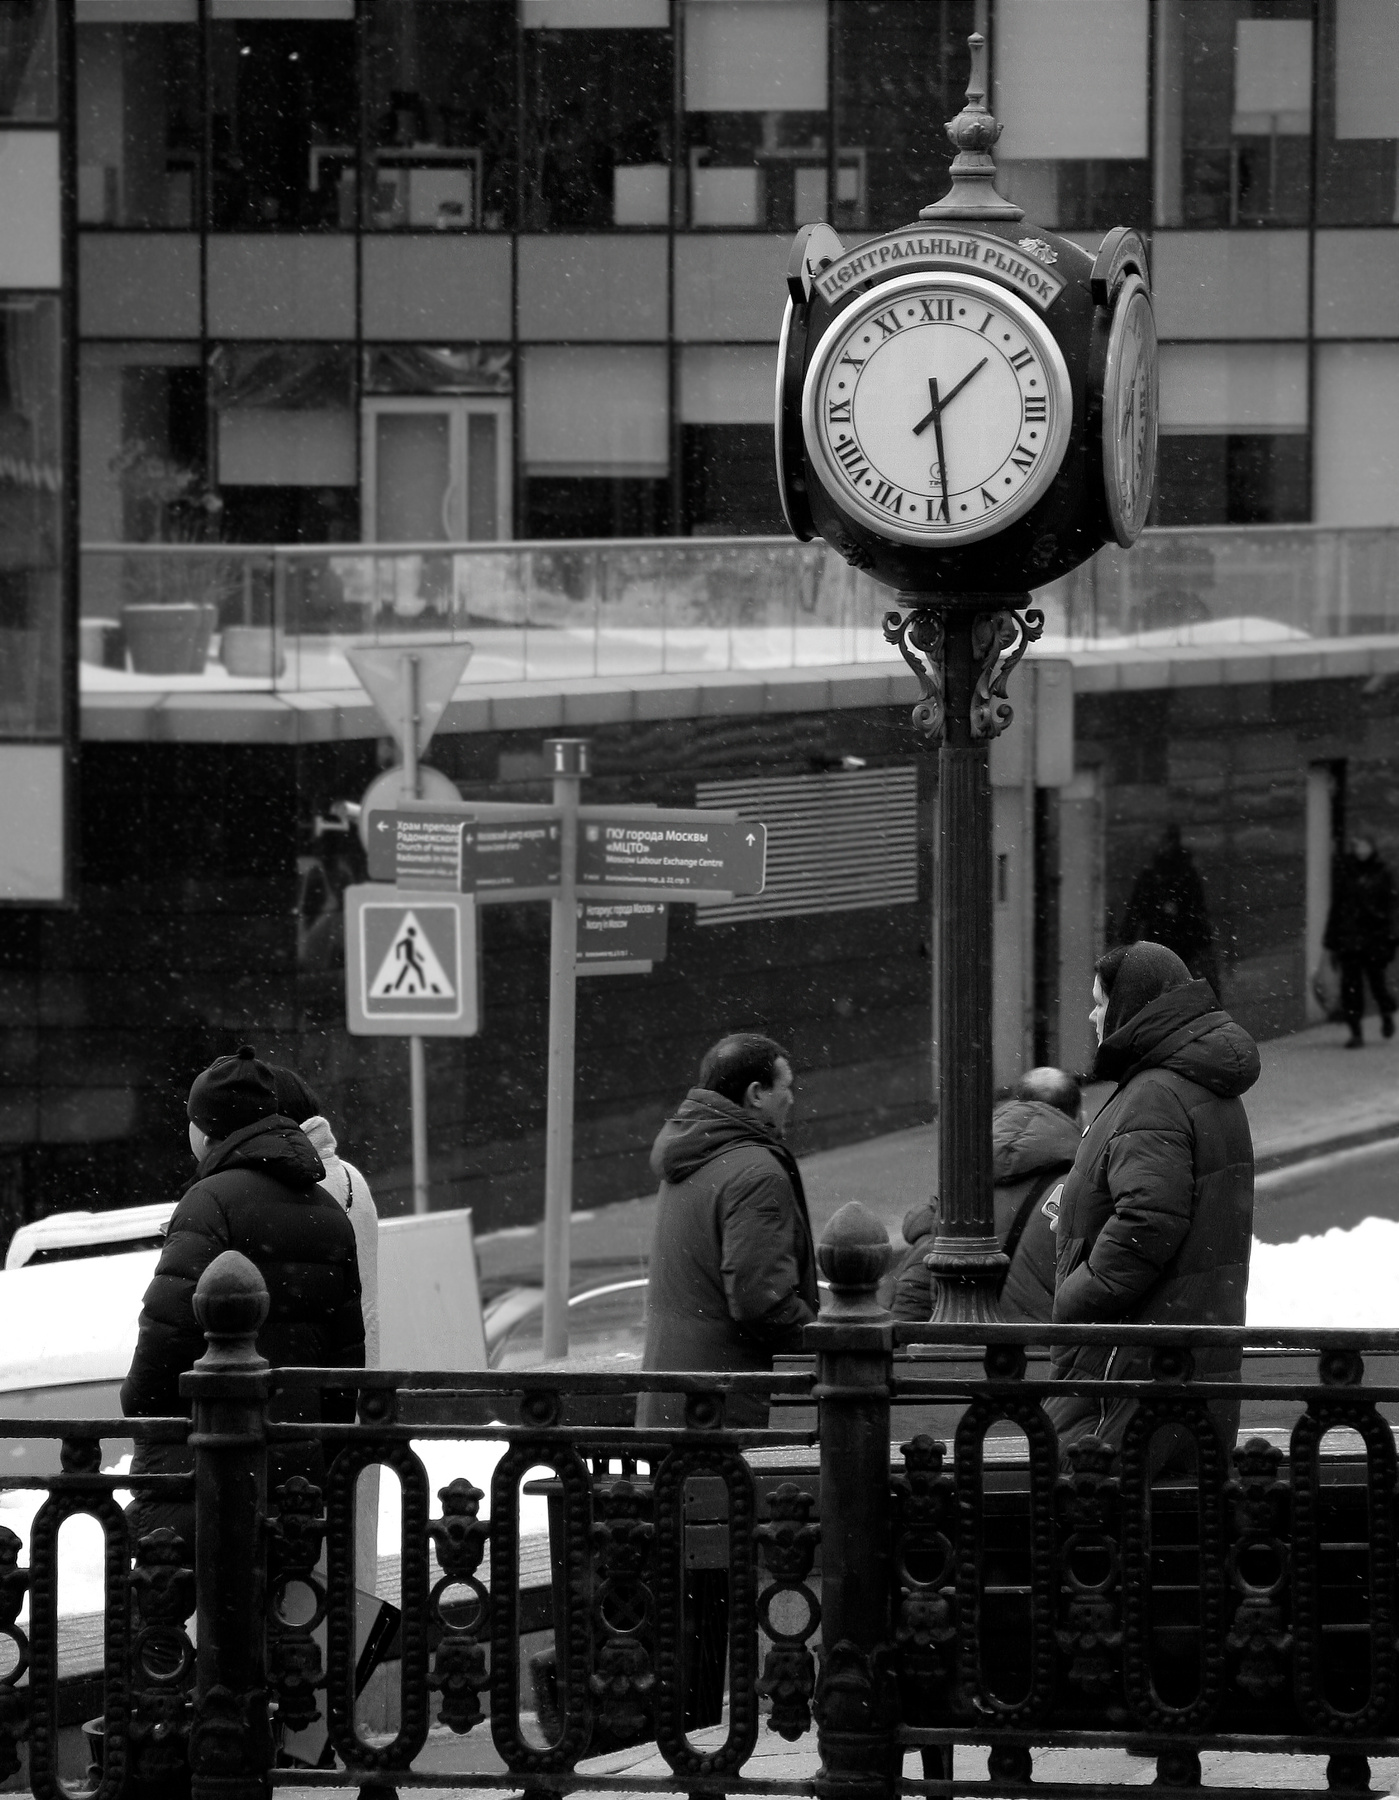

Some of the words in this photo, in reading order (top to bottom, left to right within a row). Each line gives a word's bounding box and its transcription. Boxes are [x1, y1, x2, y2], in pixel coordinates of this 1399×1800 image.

[821, 239, 980, 295] ЦЕНТРАЛЬНЫЙ
[983, 248, 1054, 300] РЫНОК
[919, 298, 954, 321] XII
[872, 309, 903, 340] XI
[978, 311, 995, 334] I
[840, 350, 866, 373] X
[1009, 346, 1036, 371] II
[829, 398, 851, 423] IX
[1024, 395, 1046, 423] III
[834, 436, 870, 485] VIII
[1010, 443, 1038, 475] IV
[869, 479, 904, 514] VII
[980, 486, 999, 509] V
[397, 821, 421, 832] Храм
[606, 828, 626, 840] ГКУ
[626, 830, 664, 843] города
[665, 830, 709, 843] Москвы
[606, 841, 650, 855] «МЦТО»
[605, 854, 635, 864] Moscow
[636, 855, 662, 866] Labour
[663, 856, 698, 869] Exchange
[699, 858, 724, 868] Centre
